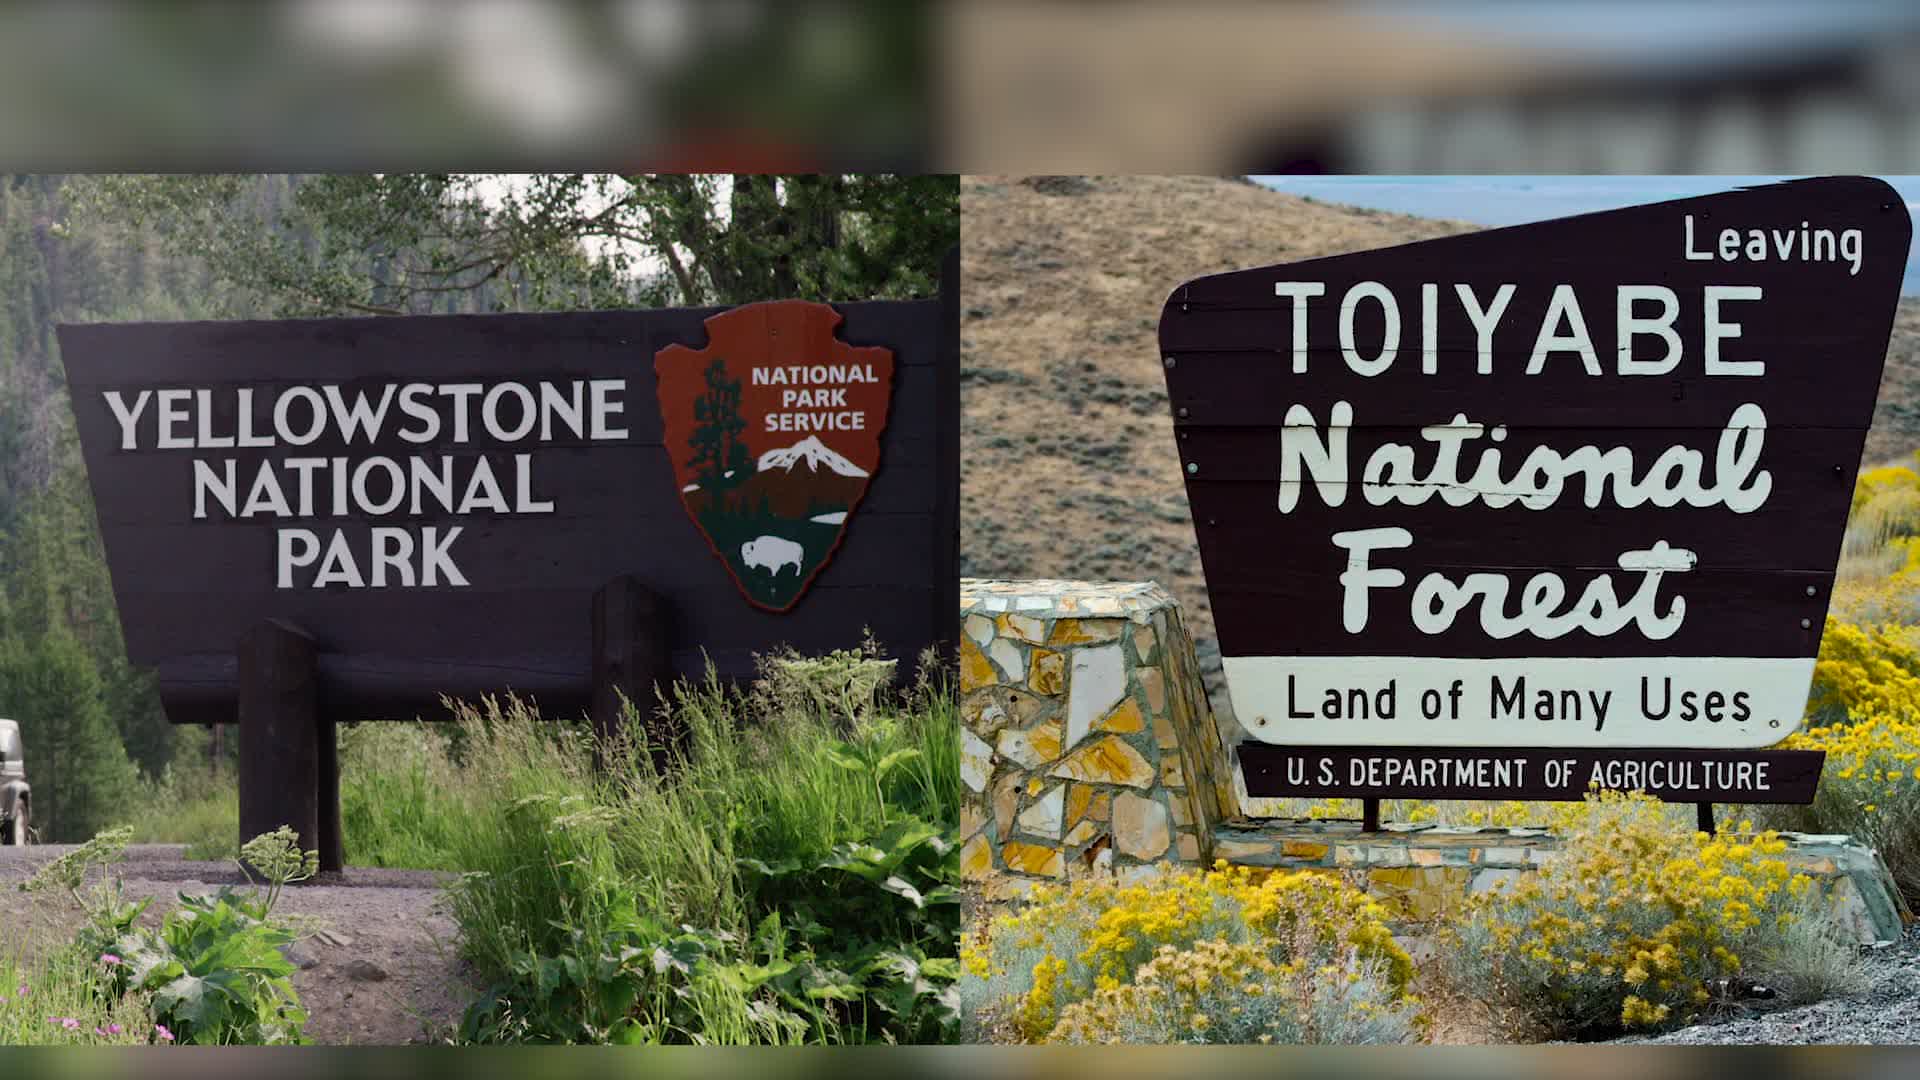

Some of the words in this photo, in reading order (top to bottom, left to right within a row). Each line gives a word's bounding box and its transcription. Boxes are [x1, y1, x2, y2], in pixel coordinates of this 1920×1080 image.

[1685, 214, 1863, 276] Leaving
[1275, 281, 1765, 377] TOIYABE
[752, 364, 879, 386] NATIONAL
[782, 388, 847, 408] PARK
[103, 379, 629, 450] YELLOWSTONE
[764, 411, 865, 432] SERVICE
[194, 453, 554, 519] NATIONAL
[1278, 400, 1773, 514] National
[277, 526, 470, 589] PARK
[1331, 526, 1698, 640] Forest
[1288, 674, 1396, 720] Land
[1420, 679, 1463, 720] of
[1490, 675, 1613, 732] Many
[1640, 676, 1752, 723] Uses
[1350, 757, 1527, 788] DEPARTMENT
[1544, 759, 1577, 788] OF
[1590, 759, 1771, 790] AGRICULTURE
